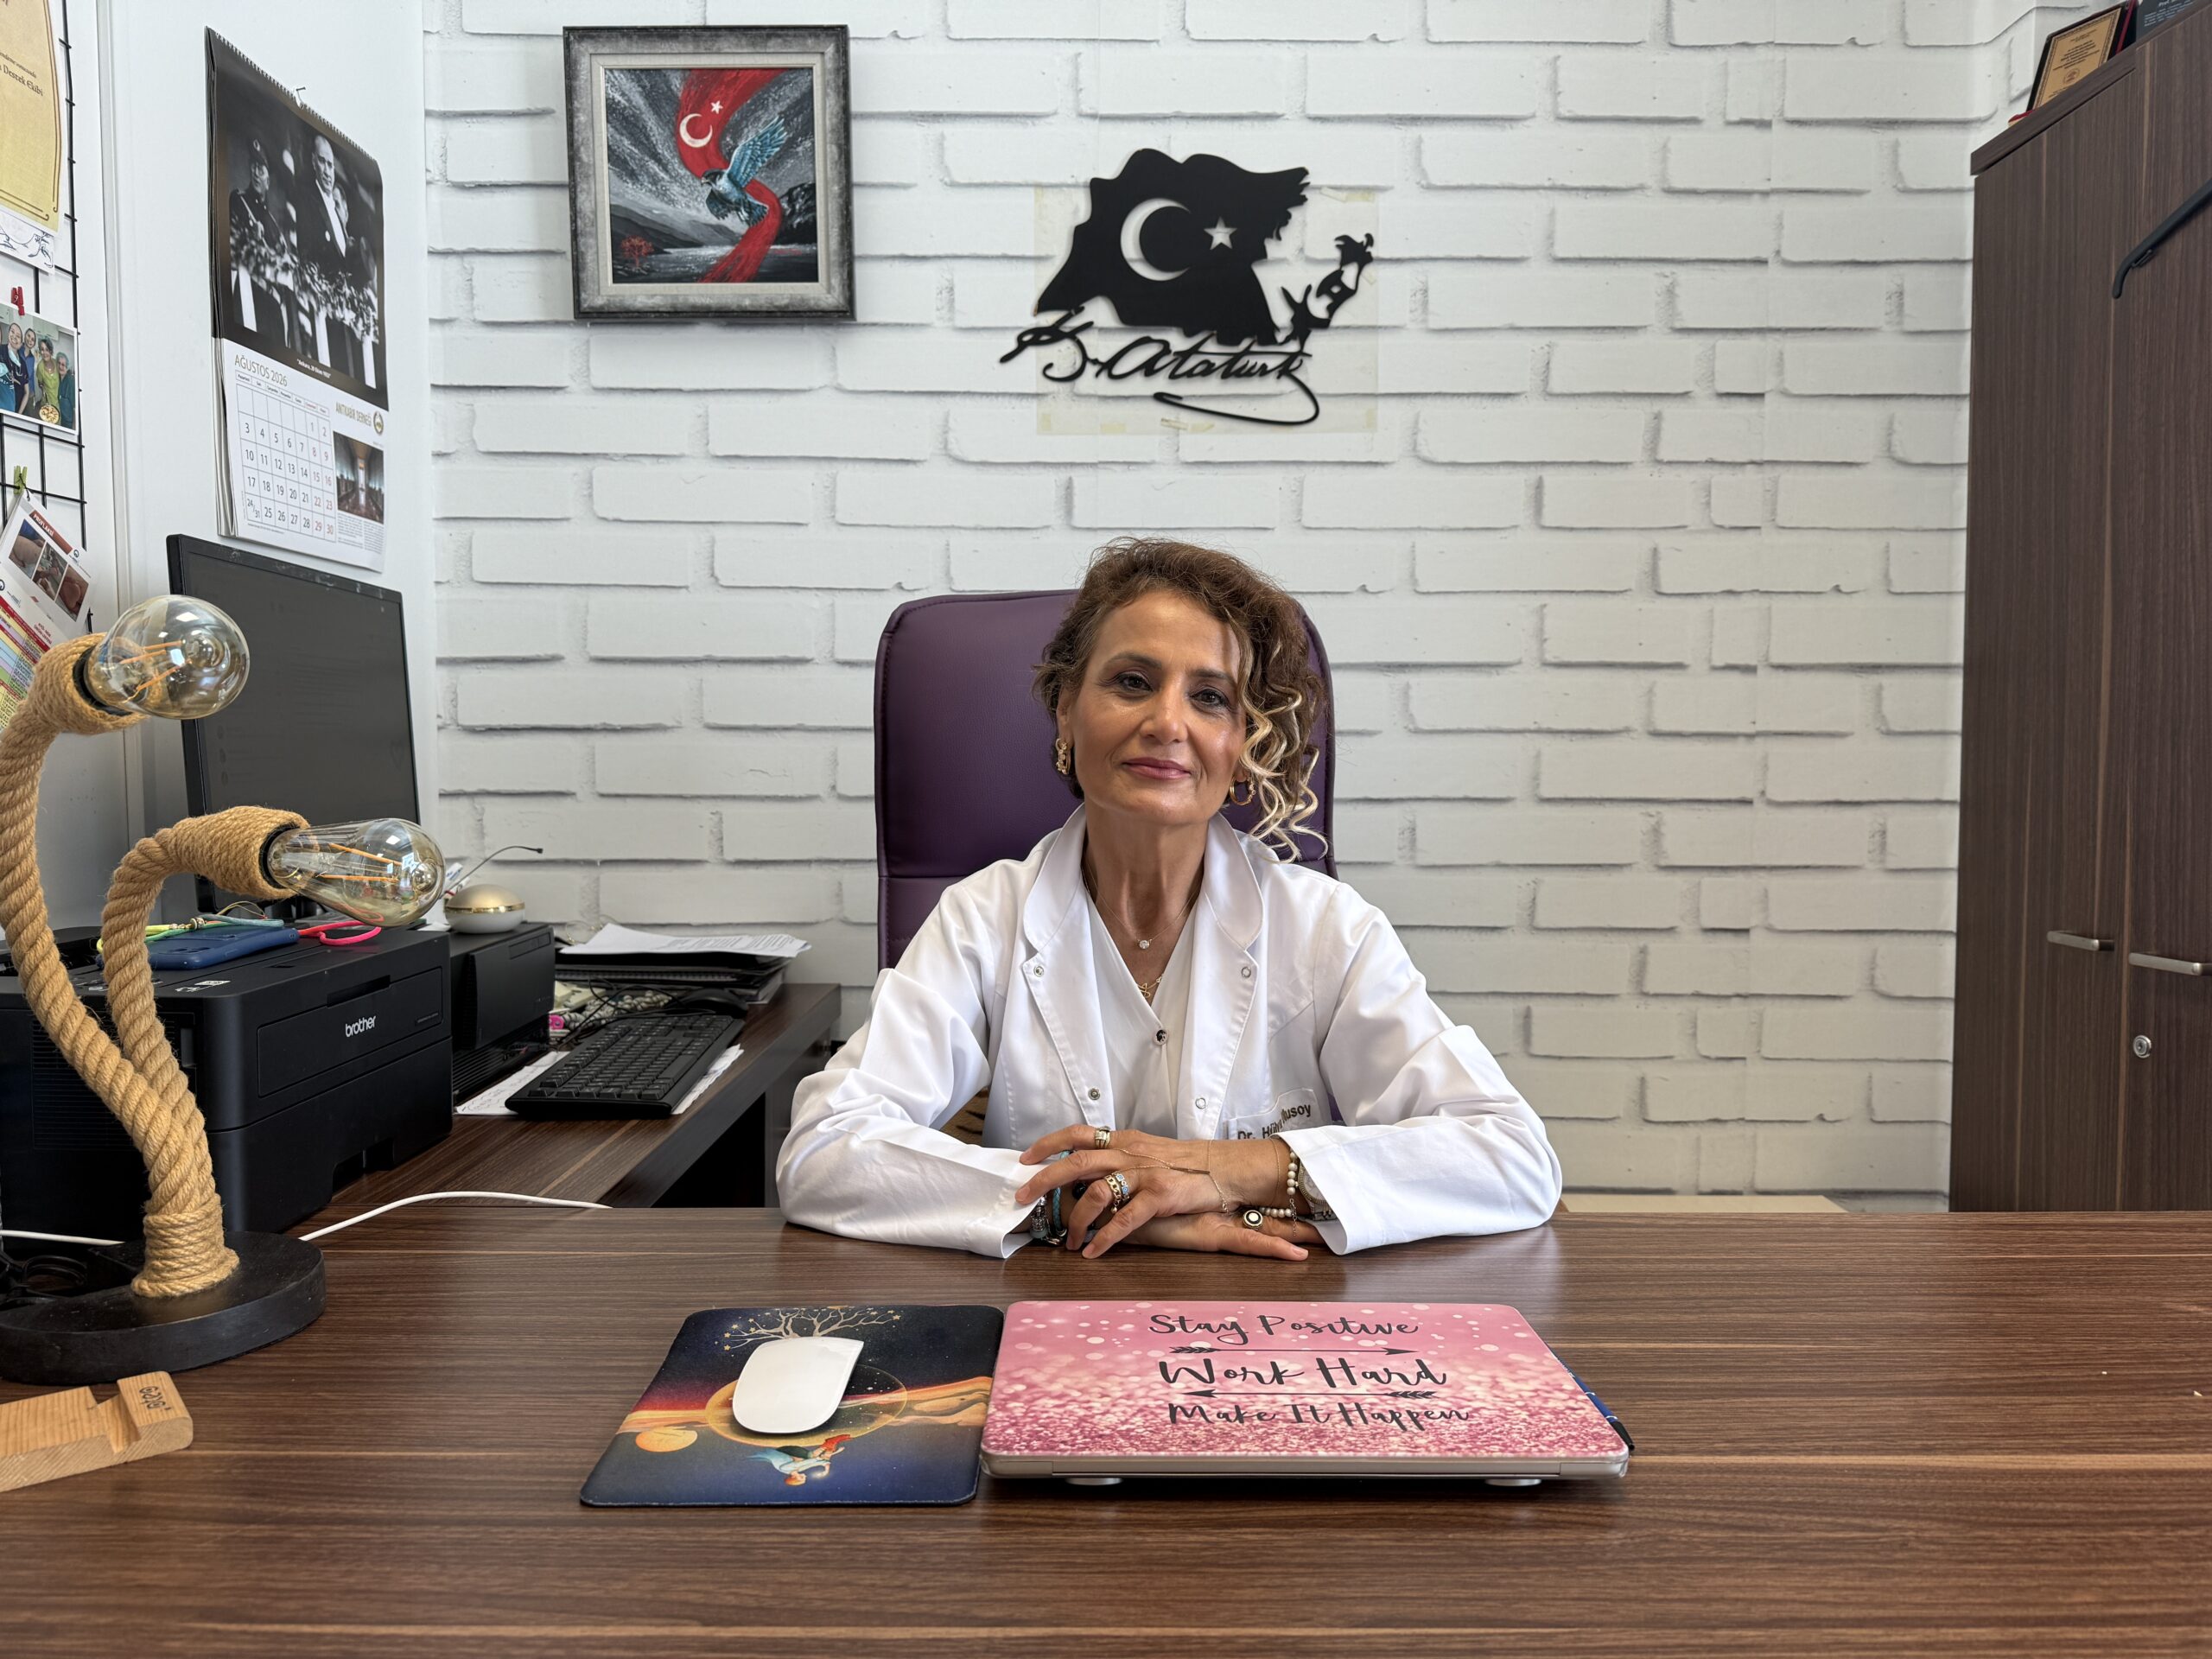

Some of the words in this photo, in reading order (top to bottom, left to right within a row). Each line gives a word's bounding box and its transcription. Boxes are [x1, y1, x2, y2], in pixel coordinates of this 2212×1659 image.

[234, 353, 270, 380] AĞUSTOS
[270, 370, 289, 388] 2026
[245, 423, 250, 434] 3
[260, 428, 264, 439] 4
[274, 432, 278, 443] 5
[287, 437, 292, 448] 6
[300, 442, 304, 452] 7
[322, 427, 327, 437] 2
[245, 448, 255, 461] 10
[260, 454, 268, 466] 11
[275, 458, 283, 470] 12
[288, 462, 296, 474] 13
[300, 467, 308, 478] 14
[313, 471, 321, 482] 15
[247, 476, 256, 487] 17
[263, 480, 271, 493] 18
[276, 484, 284, 496] 19
[289, 488, 297, 500] 20
[302, 492, 309, 504] 21
[314, 495, 321, 508] 22
[264, 506, 273, 518] 25
[277, 510, 286, 522] 26
[290, 513, 298, 525] 27
[303, 517, 310, 529] 28
[345, 1014, 377, 1038] brother
[1149, 1314, 1249, 1345] Stay
[1256, 1314, 1419, 1336] Positive
[1159, 1357, 1305, 1385] Work
[1316, 1357, 1447, 1389] Hard
[1168, 1402, 1276, 1425] Make
[1283, 1403, 1331, 1424] It
[1338, 1402, 1470, 1431] Happen
